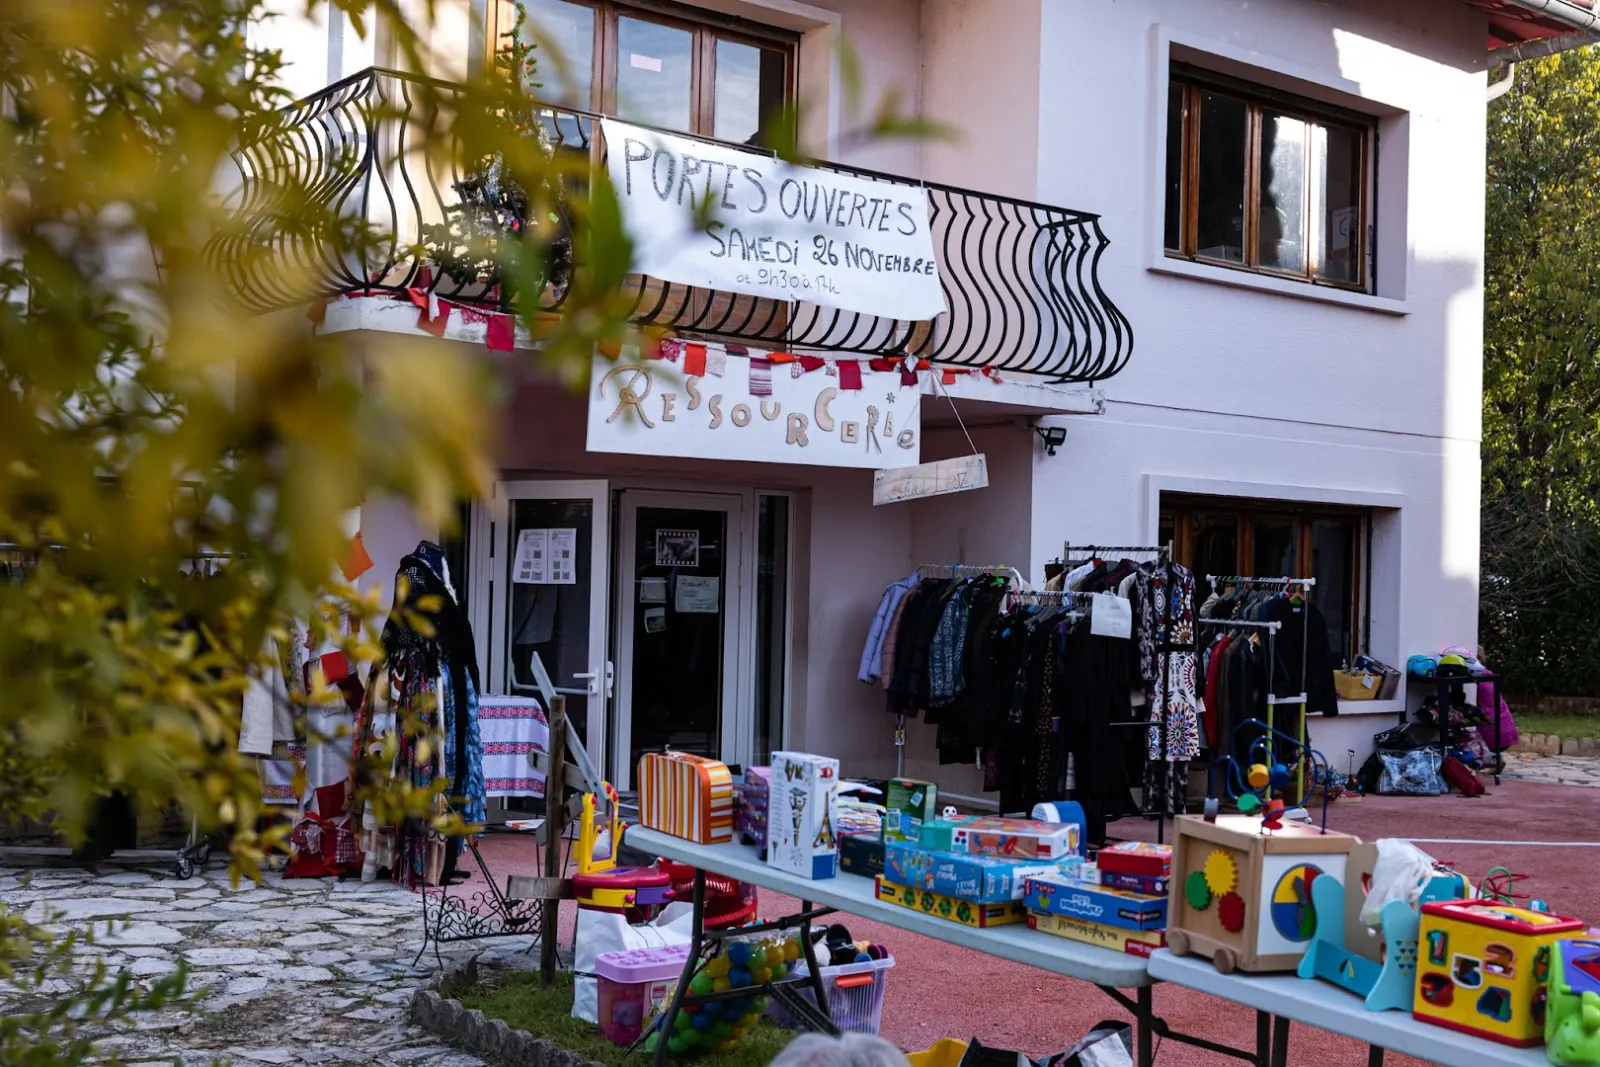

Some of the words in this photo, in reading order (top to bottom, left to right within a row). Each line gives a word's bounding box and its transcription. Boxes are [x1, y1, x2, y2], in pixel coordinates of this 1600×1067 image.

[624, 138, 767, 214] PORTES
[779, 178, 917, 236] OUVERTES
[812, 234, 839, 267] 26
[845, 241, 936, 276] NOVEMBRE
[758, 268, 800, 289] 9h30
